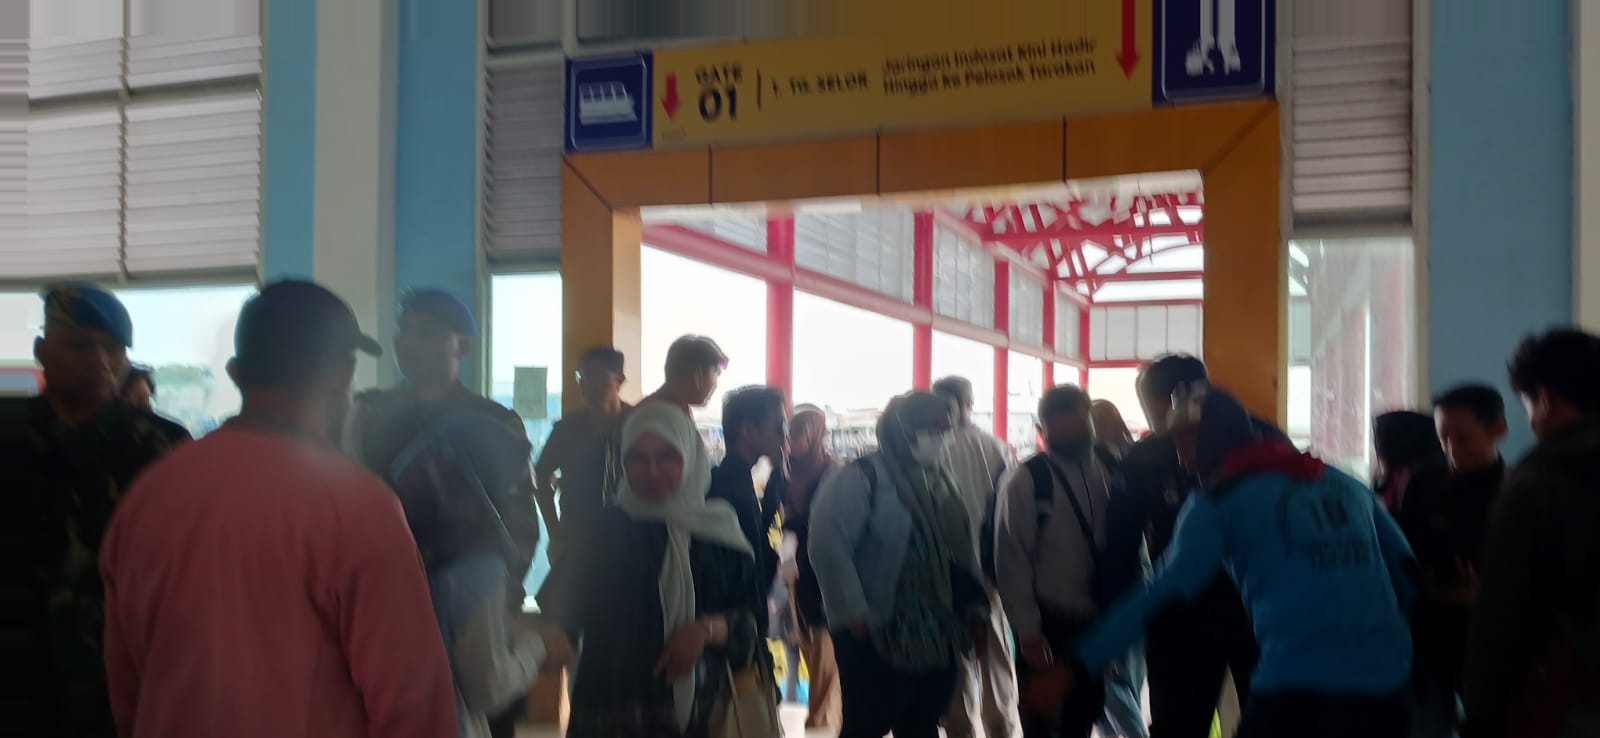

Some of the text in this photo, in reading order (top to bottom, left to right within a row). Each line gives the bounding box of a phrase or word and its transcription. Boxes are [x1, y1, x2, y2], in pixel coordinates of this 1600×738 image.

[881, 36, 1098, 76] Jaringan Indosat Kini Hadir
[695, 62, 743, 86] GATE
[816, 69, 869, 95] SELOR
[883, 76, 938, 98] Hingga
[942, 72, 961, 90] ke
[1028, 58, 1096, 81] Tarakan
[698, 87, 738, 122] 01
